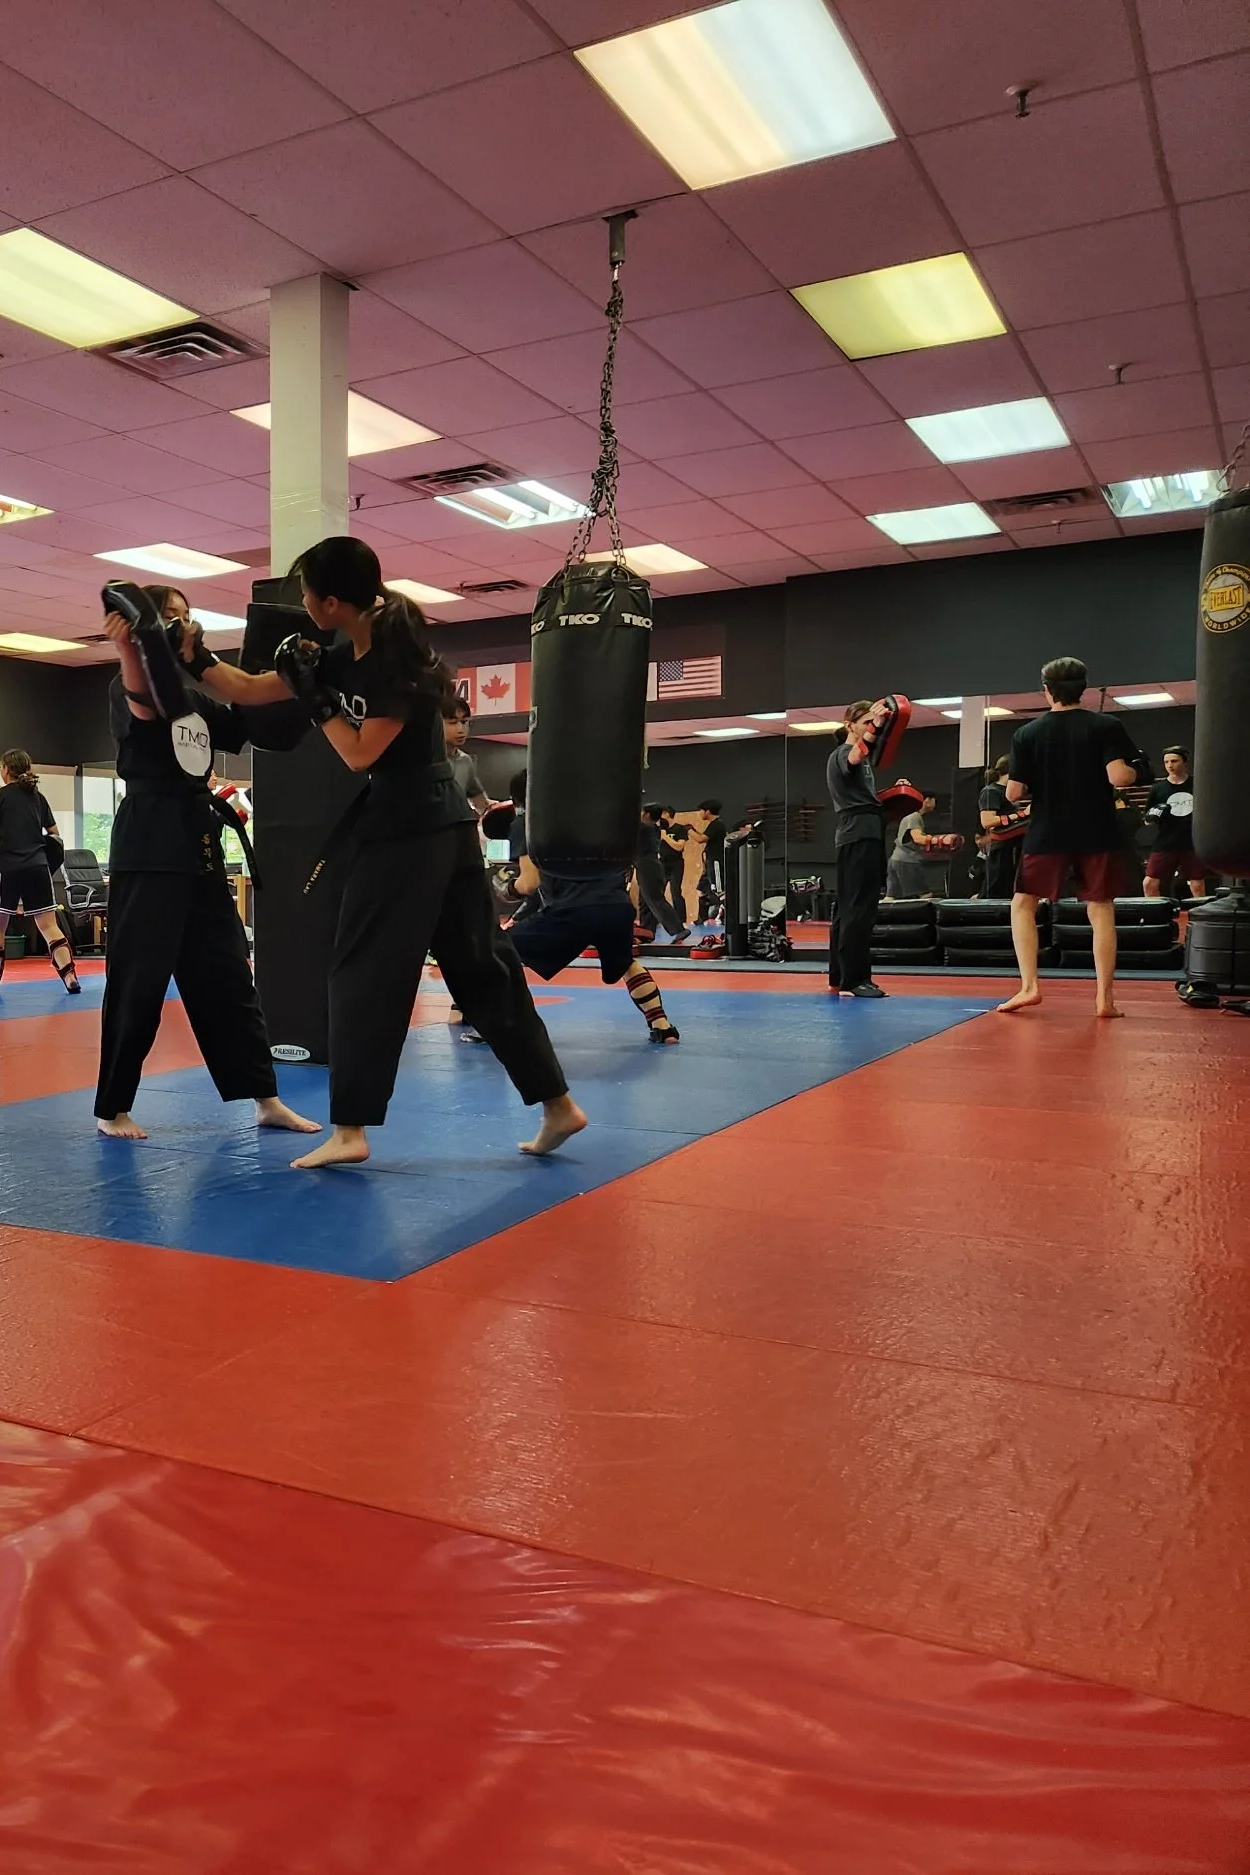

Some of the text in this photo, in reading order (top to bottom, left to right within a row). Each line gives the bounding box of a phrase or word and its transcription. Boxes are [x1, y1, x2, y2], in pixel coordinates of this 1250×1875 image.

[559, 613, 600, 627] TKO
[621, 612, 653, 629] TKO
[178, 725, 209, 748] TMD
